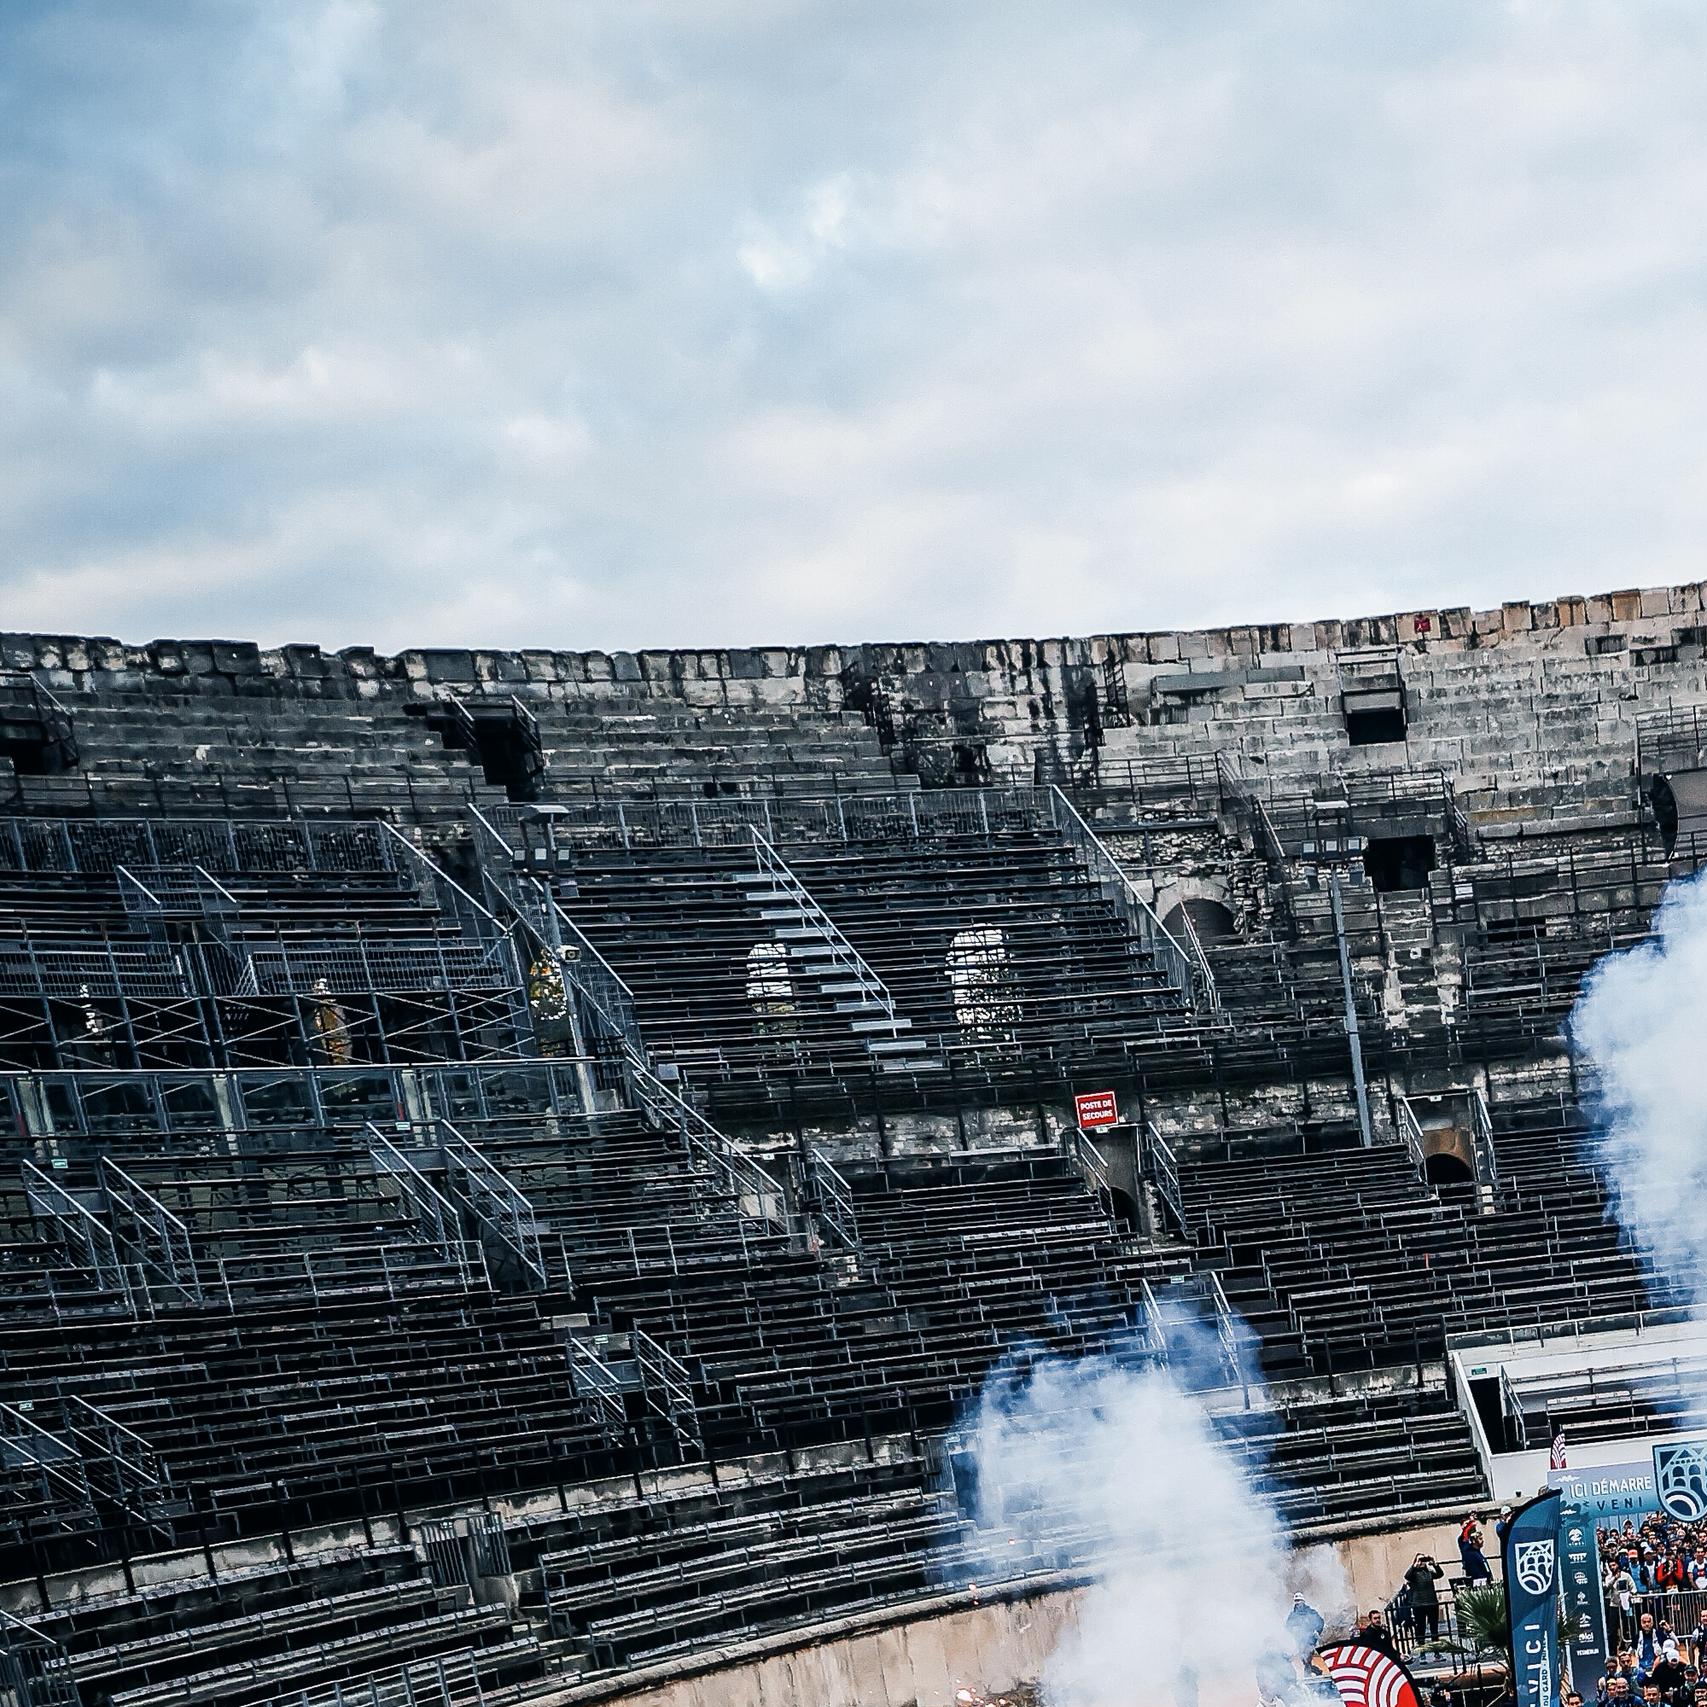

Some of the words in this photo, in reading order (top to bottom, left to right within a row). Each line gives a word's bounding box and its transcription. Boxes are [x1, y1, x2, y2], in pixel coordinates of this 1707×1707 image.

[1080, 1101, 1102, 1110] POSTE
[1082, 1110, 1113, 1120] SECOURS
[1570, 1483, 1587, 1498] ICI
[1591, 1477, 1652, 1497] DÉMARRE
[1597, 1496, 1642, 1511] VENI
